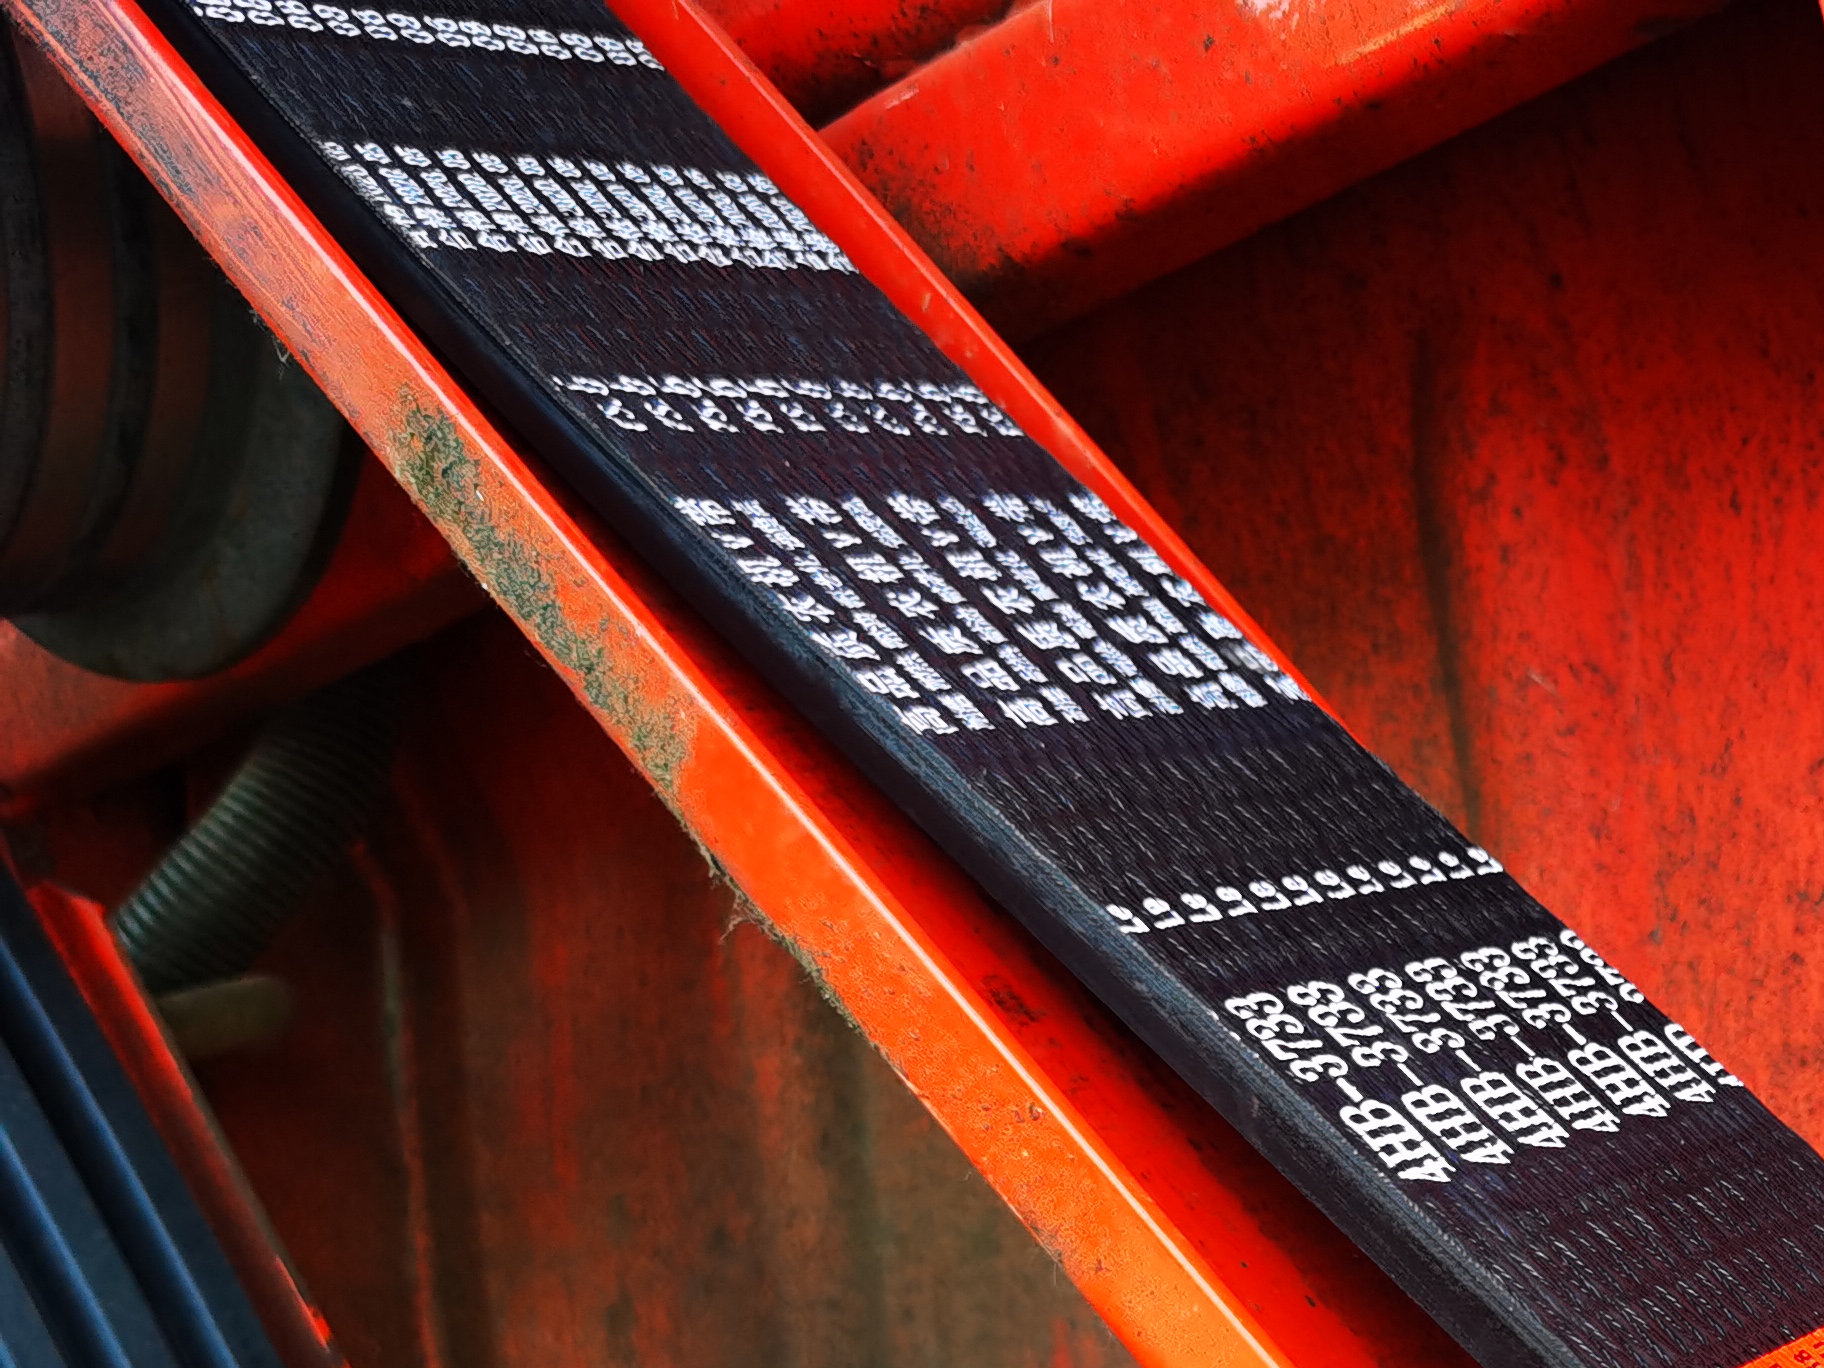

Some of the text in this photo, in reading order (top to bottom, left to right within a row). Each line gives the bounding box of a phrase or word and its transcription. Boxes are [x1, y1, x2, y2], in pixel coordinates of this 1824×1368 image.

[673, 496, 960, 736] 高品质农机V带
[785, 496, 1059, 729] 高品质农机V带
[886, 493, 1154, 720] 高品质农机V带
[1224, 991, 1457, 1183] 4HB-3733
[1286, 980, 1515, 1165] 4HB-3733
[1347, 967, 1571, 1148] 4HB-3733
[1404, 957, 1621, 1133] 4HB-3733
[1460, 946, 1672, 1118] 4HB-3733
[1510, 936, 1717, 1103] 4HB-3733
